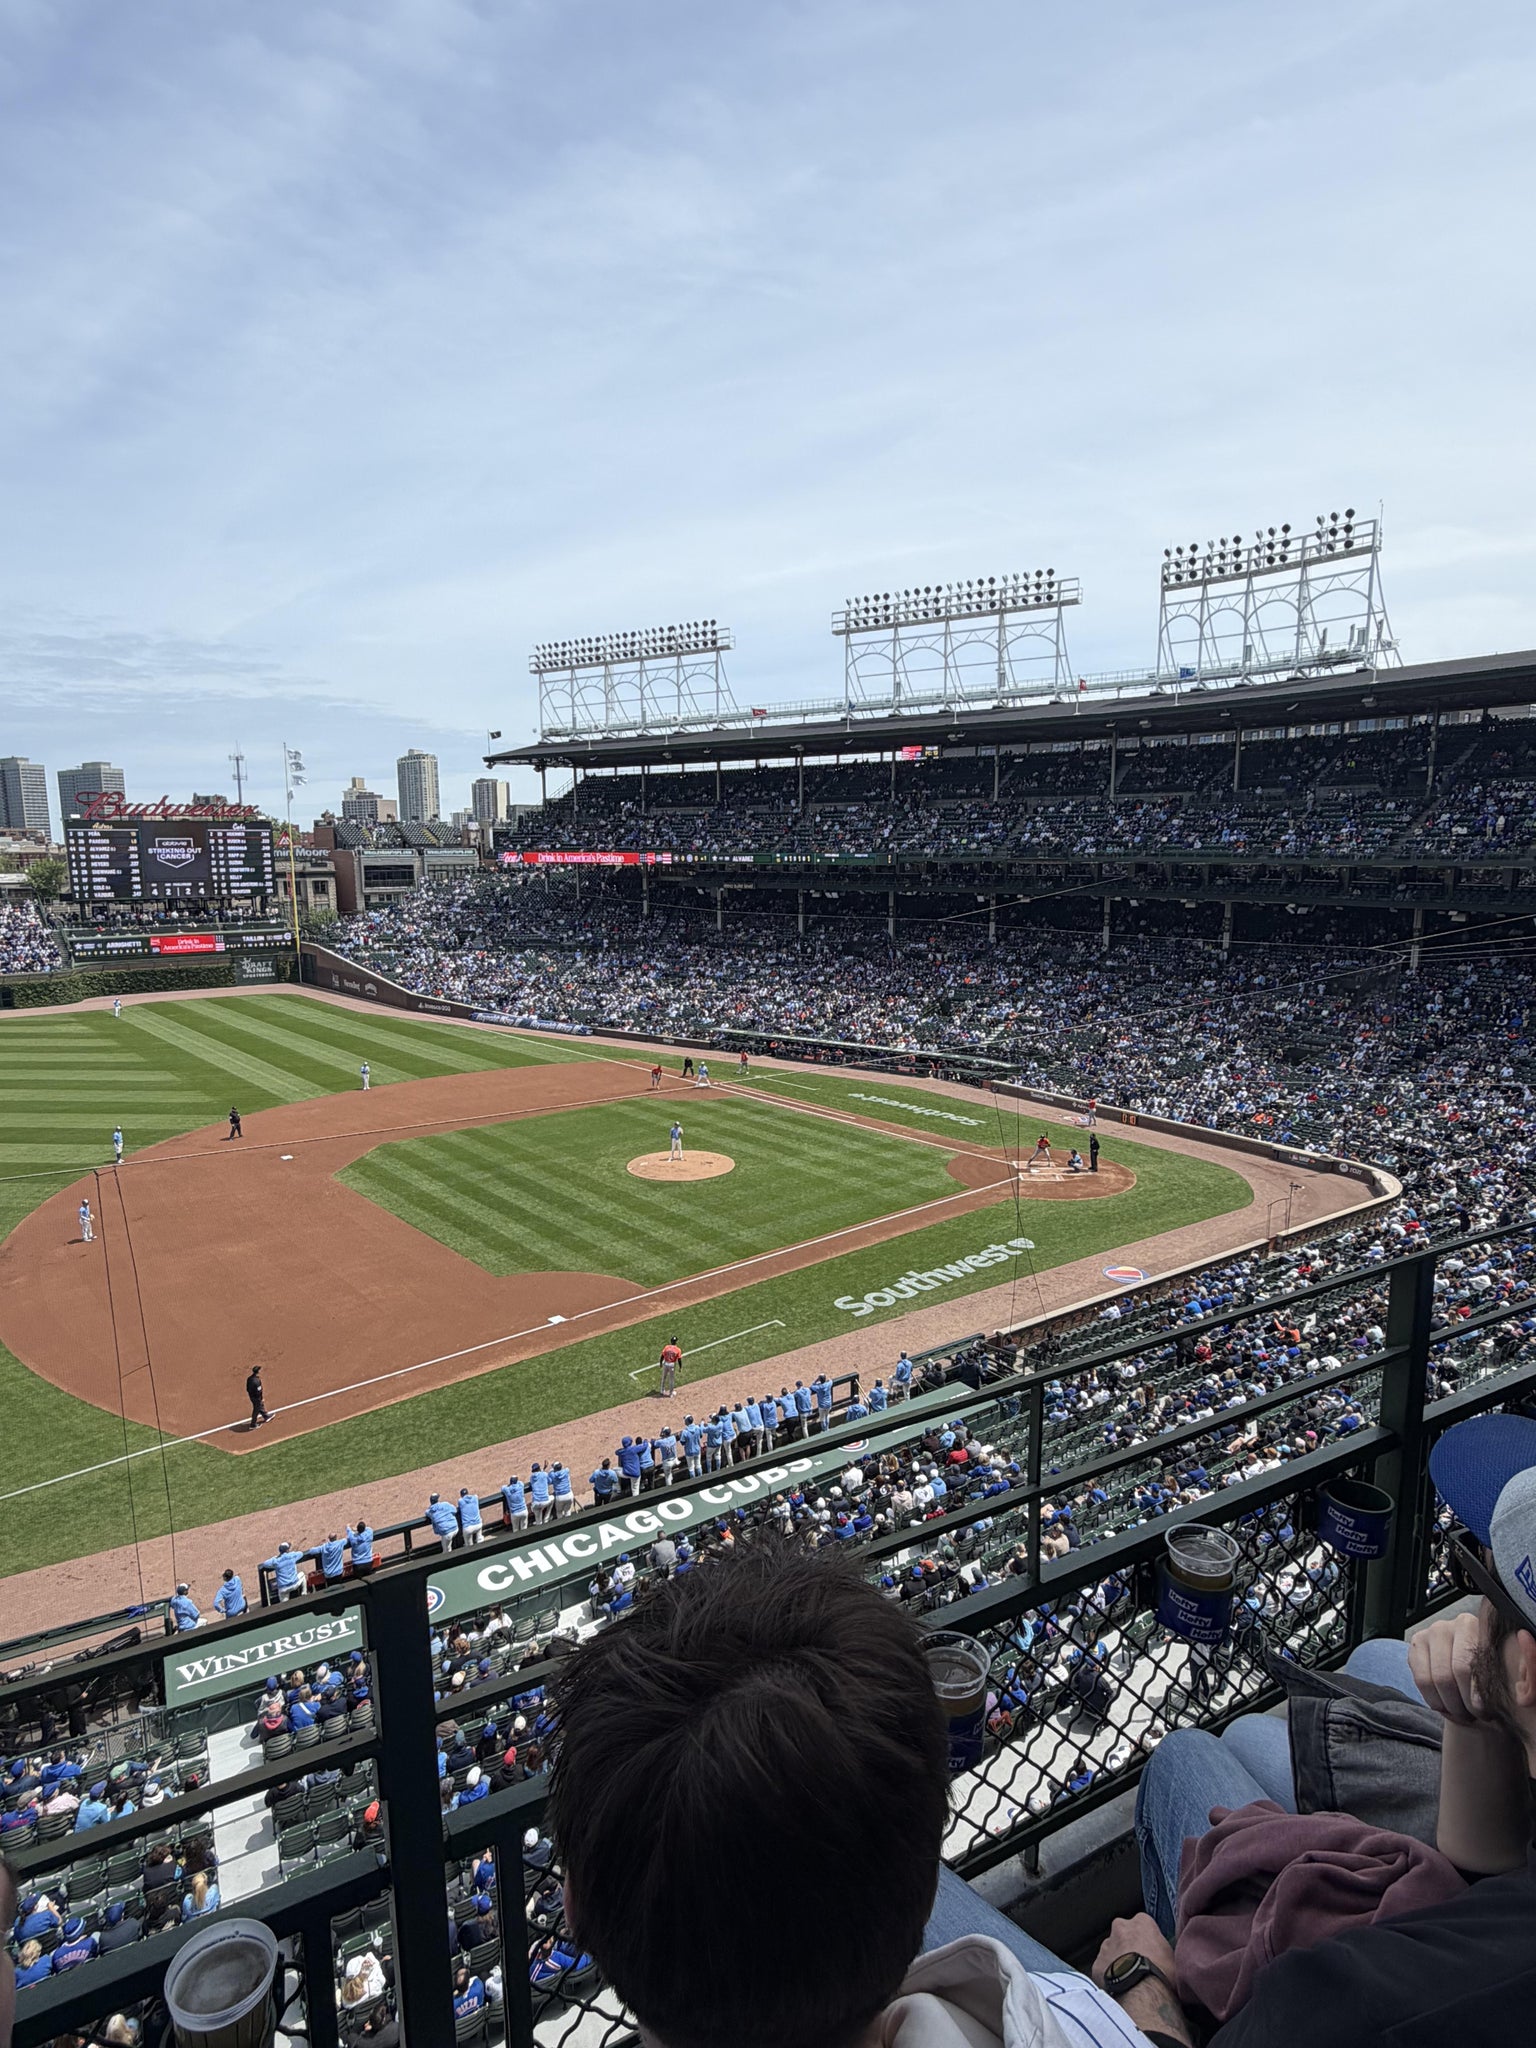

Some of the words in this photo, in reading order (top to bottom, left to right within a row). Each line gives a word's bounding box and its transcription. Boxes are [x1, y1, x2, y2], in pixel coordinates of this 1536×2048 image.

[74, 791, 259, 820] Budweiser
[295, 848, 329, 857] Moore
[538, 852, 557, 863] Drink
[563, 853, 596, 863] America's
[596, 853, 625, 864] Pastime
[151, 888, 158, 896] 4
[165, 888, 172, 896] 2
[185, 887, 191, 895] 2
[198, 887, 205, 895] 4
[243, 959, 273, 970] DRAFT
[861, 1095, 986, 1126] Southwest
[833, 1243, 1023, 1317] Southwest
[476, 1498, 695, 1591] CHICAGO
[698, 1457, 813, 1505] CUBS
[1328, 1506, 1355, 1527] Hefty
[1336, 1524, 1368, 1542] Hefty
[1346, 1541, 1378, 1554] Hefty
[1168, 1588, 1198, 1612] Hefty
[1178, 1610, 1213, 1627] Hefty
[1190, 1628, 1223, 1640] Hefty
[175, 1617, 354, 1682] WINTRUST
